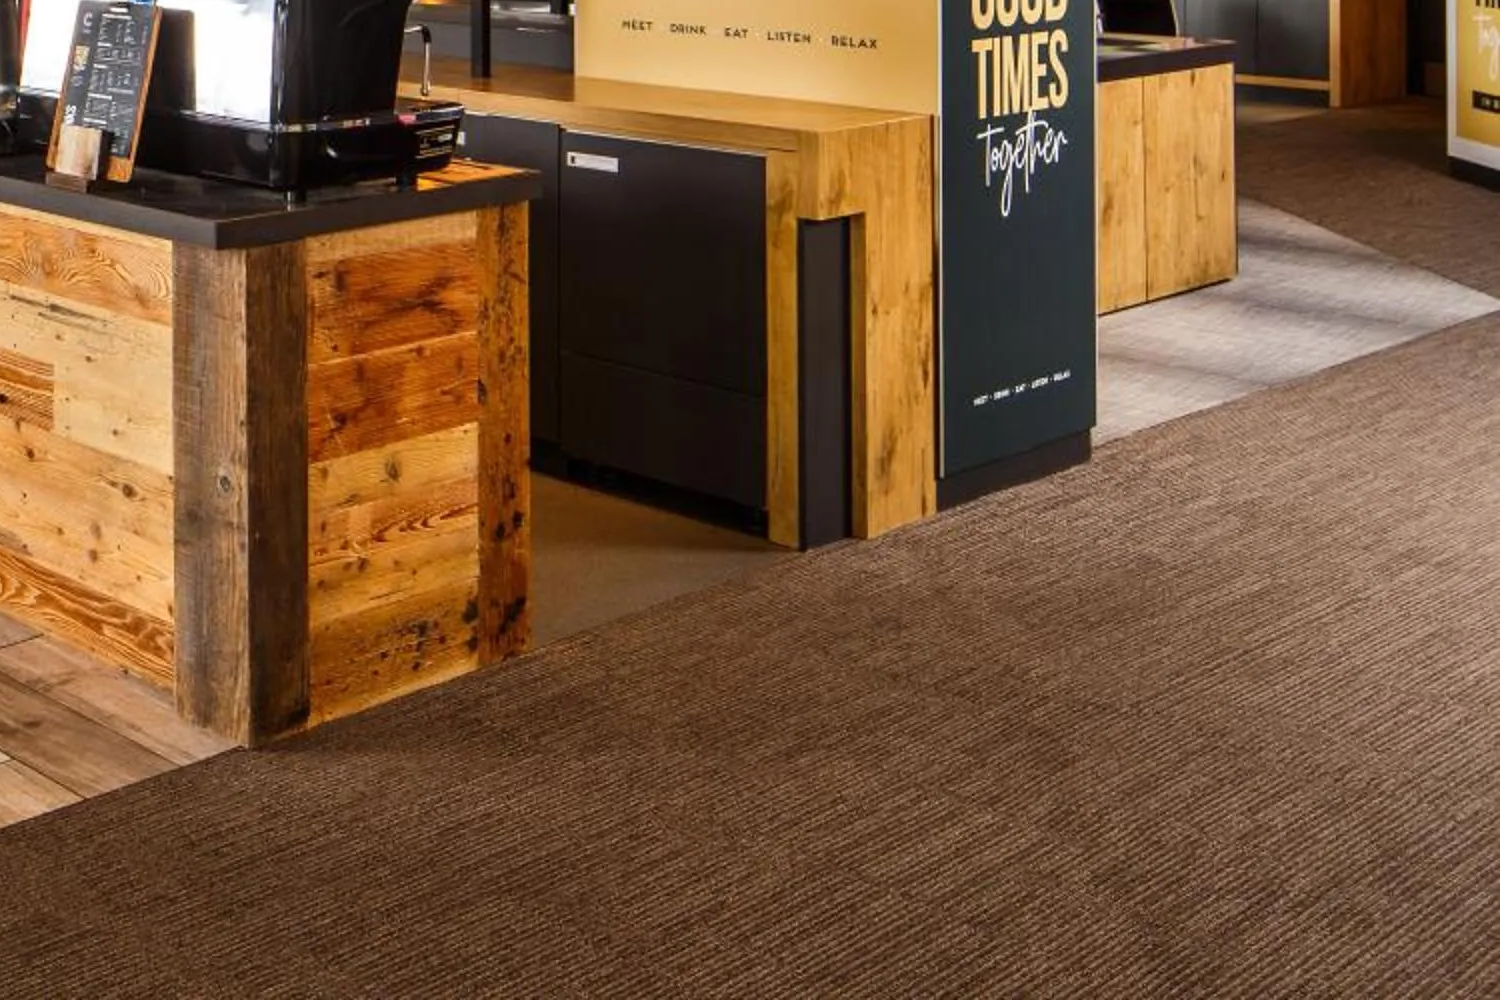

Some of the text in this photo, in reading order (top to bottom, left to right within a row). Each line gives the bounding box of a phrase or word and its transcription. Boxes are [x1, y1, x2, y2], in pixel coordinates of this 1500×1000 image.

[621, 19, 878, 50] MEET DRINK EAT LISTEN RELAX
[970, 28, 1070, 121] TIMES
